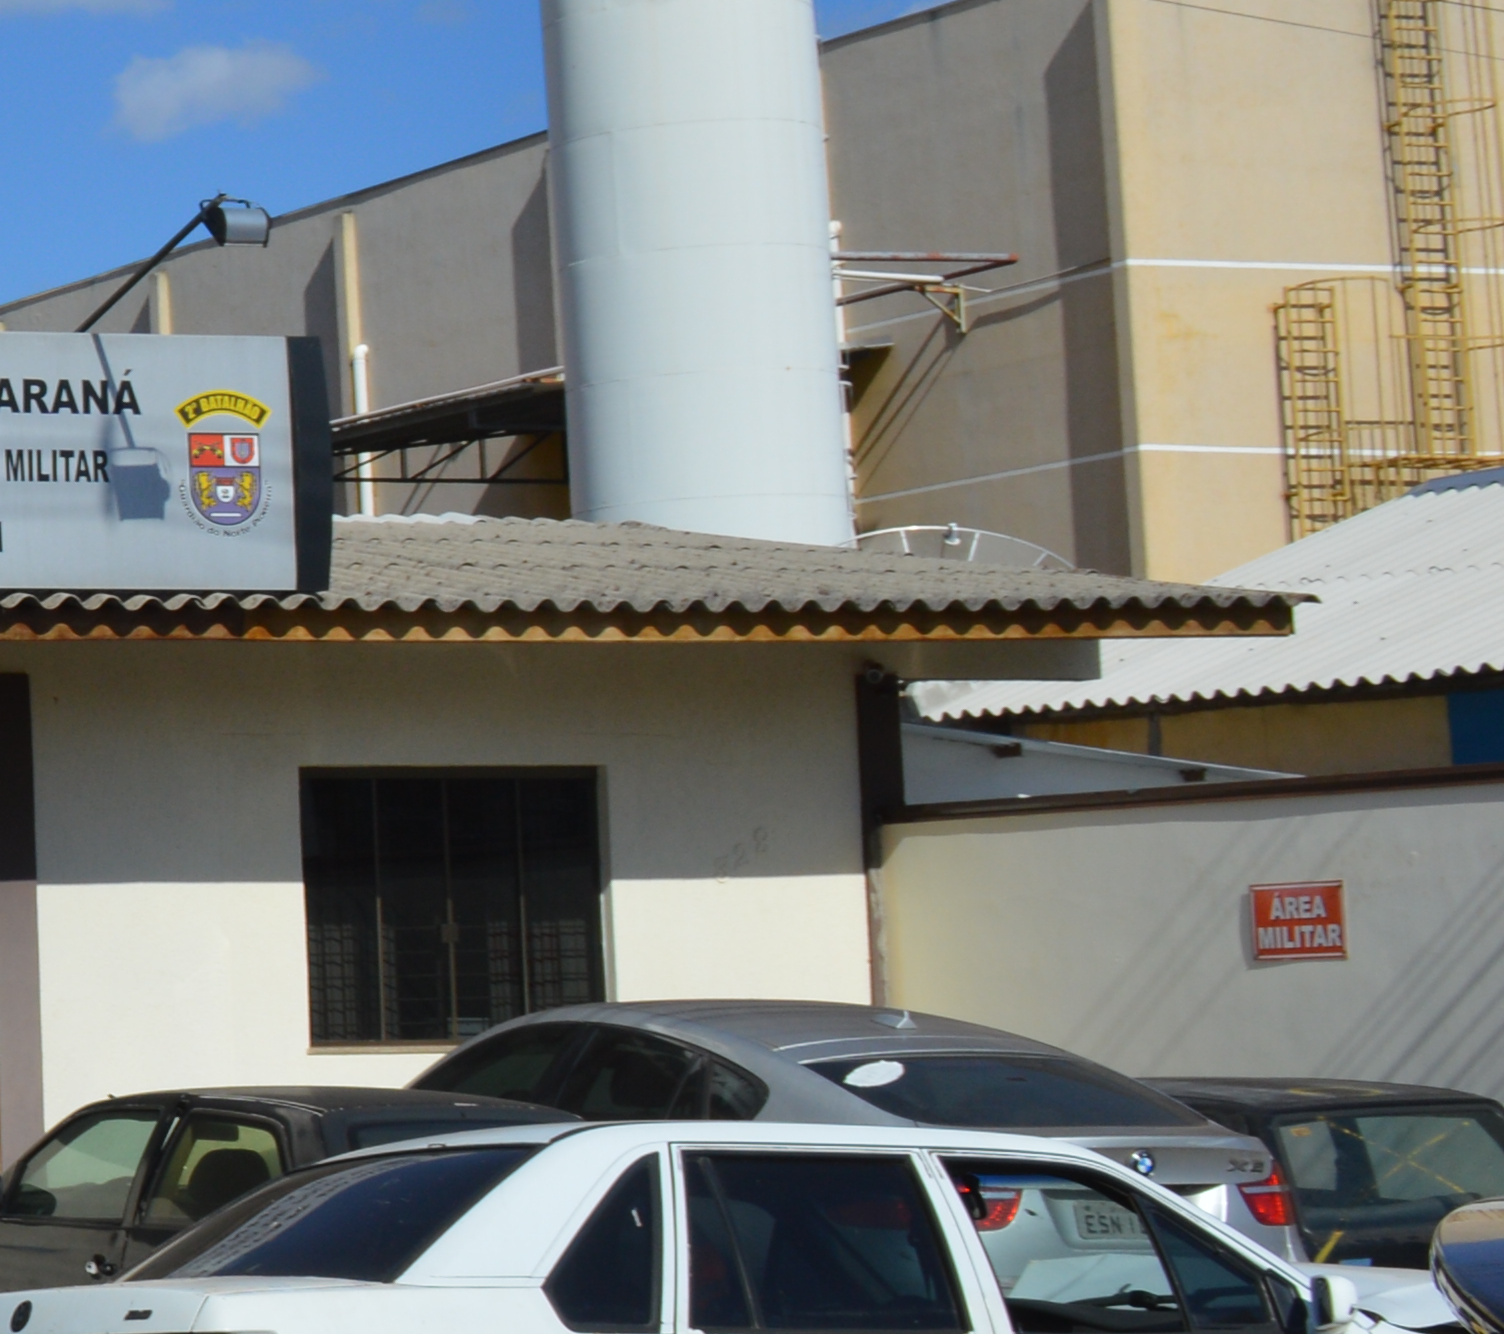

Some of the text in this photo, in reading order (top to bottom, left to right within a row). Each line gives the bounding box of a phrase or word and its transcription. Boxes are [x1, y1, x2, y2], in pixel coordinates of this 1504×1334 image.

[5, 449, 110, 483] MILITAR
[1270, 891, 1328, 920] ÁREA
[1257, 924, 1343, 949] MILITAR
